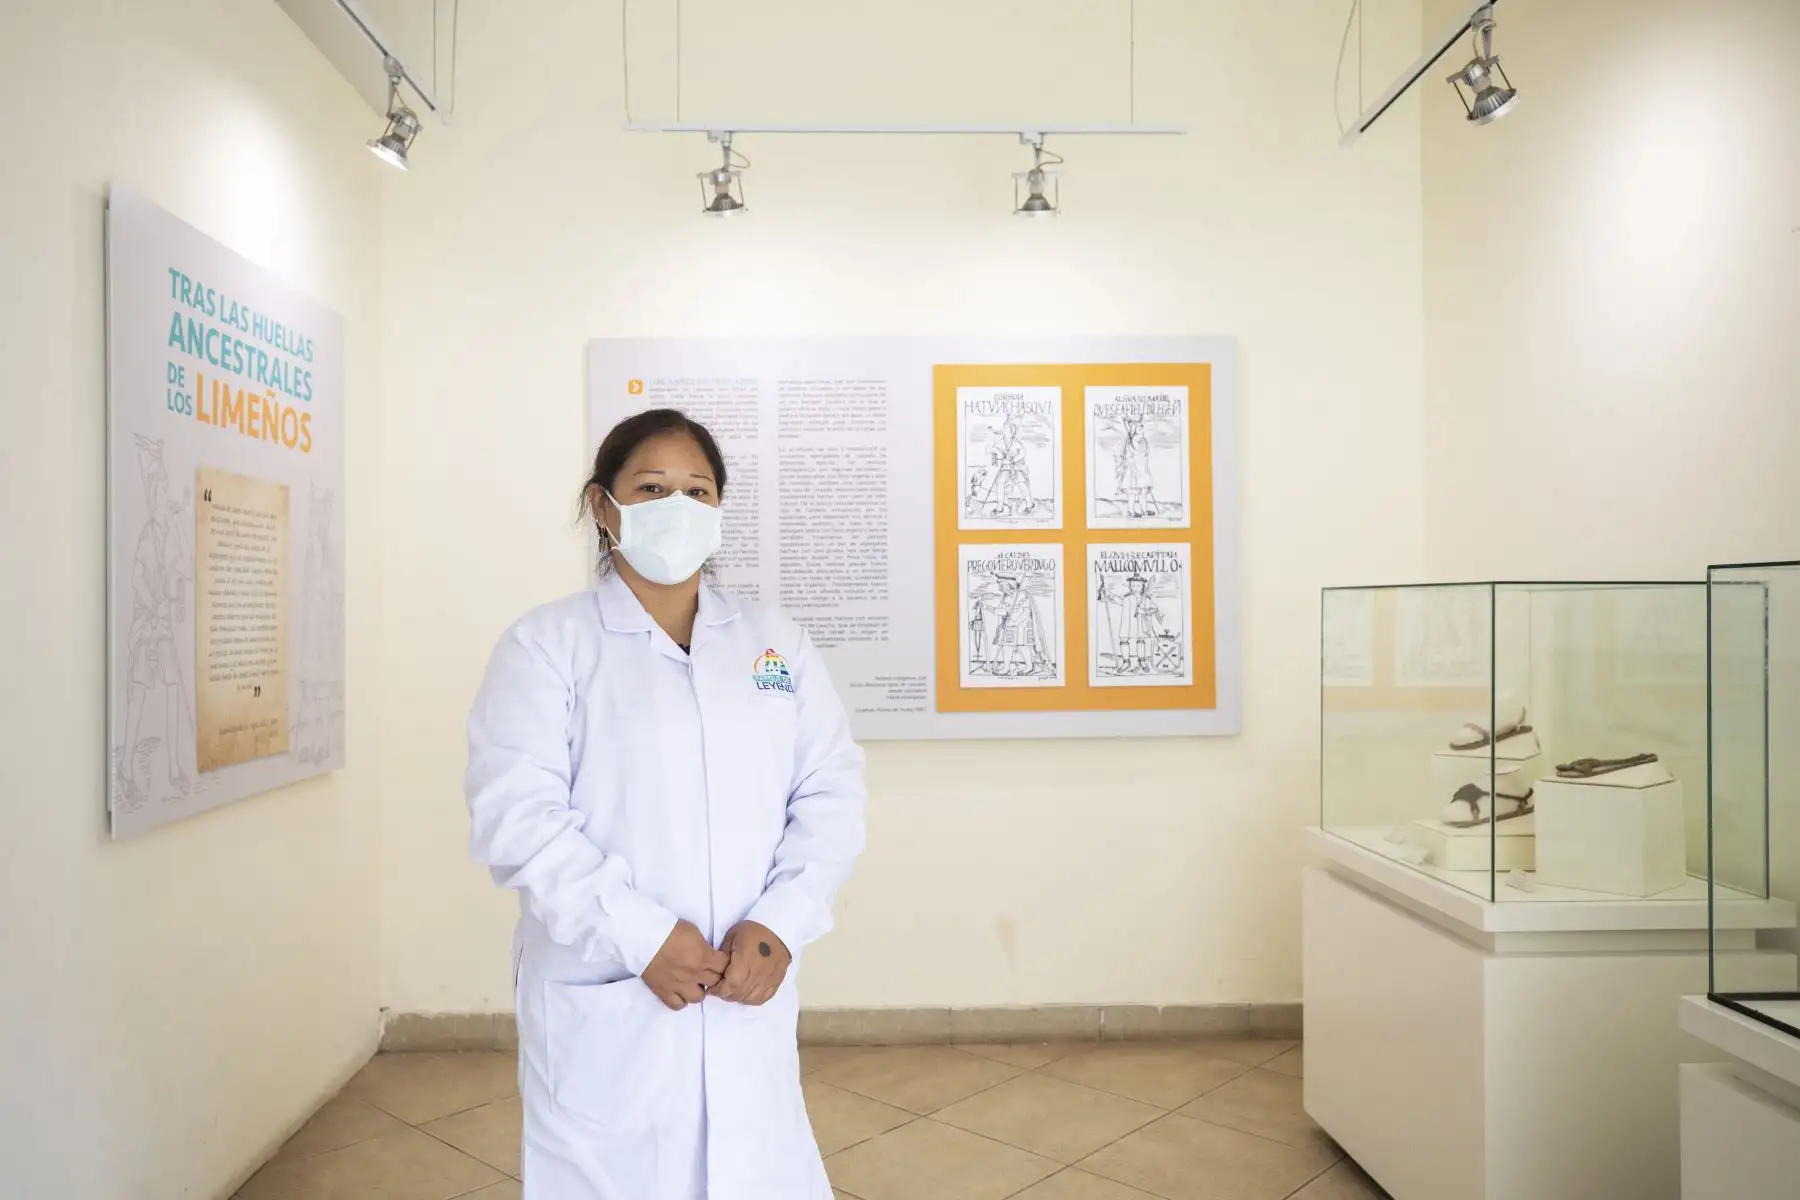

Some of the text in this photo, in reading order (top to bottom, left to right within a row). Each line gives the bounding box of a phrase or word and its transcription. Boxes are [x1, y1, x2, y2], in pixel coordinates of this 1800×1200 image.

[167, 311, 312, 402] ANCESTRALES
[168, 267, 314, 363] TRAS LAS HUELLAS
[166, 361, 185, 388] DE
[166, 371, 313, 454] LOS LIMEÑOS
